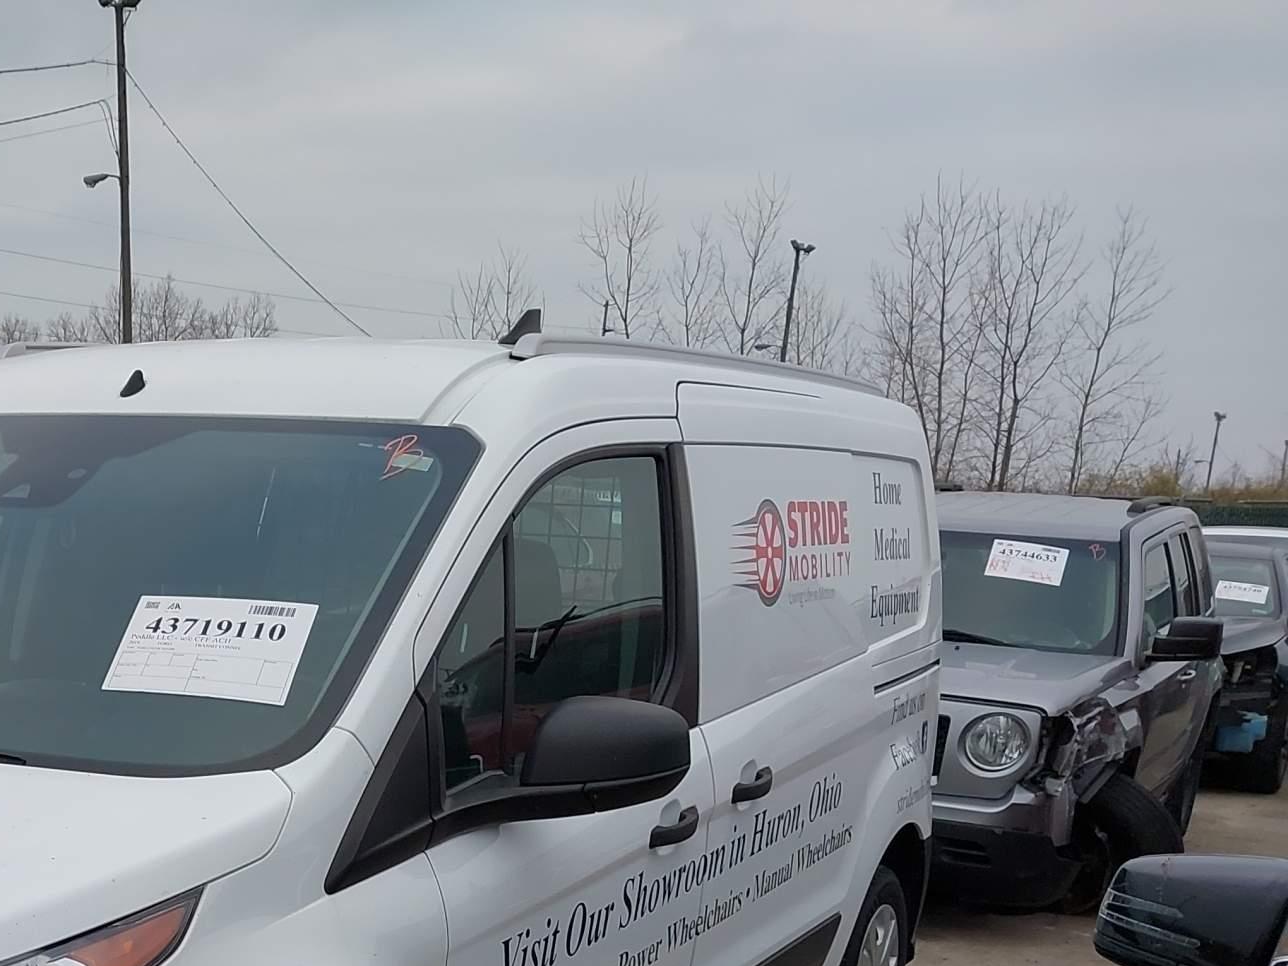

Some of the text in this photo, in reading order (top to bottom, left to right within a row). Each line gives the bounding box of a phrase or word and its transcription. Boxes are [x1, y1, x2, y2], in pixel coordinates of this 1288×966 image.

[873, 472, 902, 506] Home
[787, 501, 850, 548] STRIDE
[874, 528, 911, 561] Medical
[999, 548, 1057, 563] 43744633
[789, 551, 851, 582] MOBILITY
[871, 584, 920, 626] Equipment
[145, 616, 287, 641] 43719110
[566, 899, 615, 957] Our
[618, 843, 727, 931] Showroom
[729, 831, 746, 868] in
[750, 804, 808, 858] Huron,
[808, 771, 842, 824] Ohio
[666, 889, 744, 953] Wheelchairs
[752, 851, 795, 903] Manual
[796, 822, 853, 869] Wheelchairs
